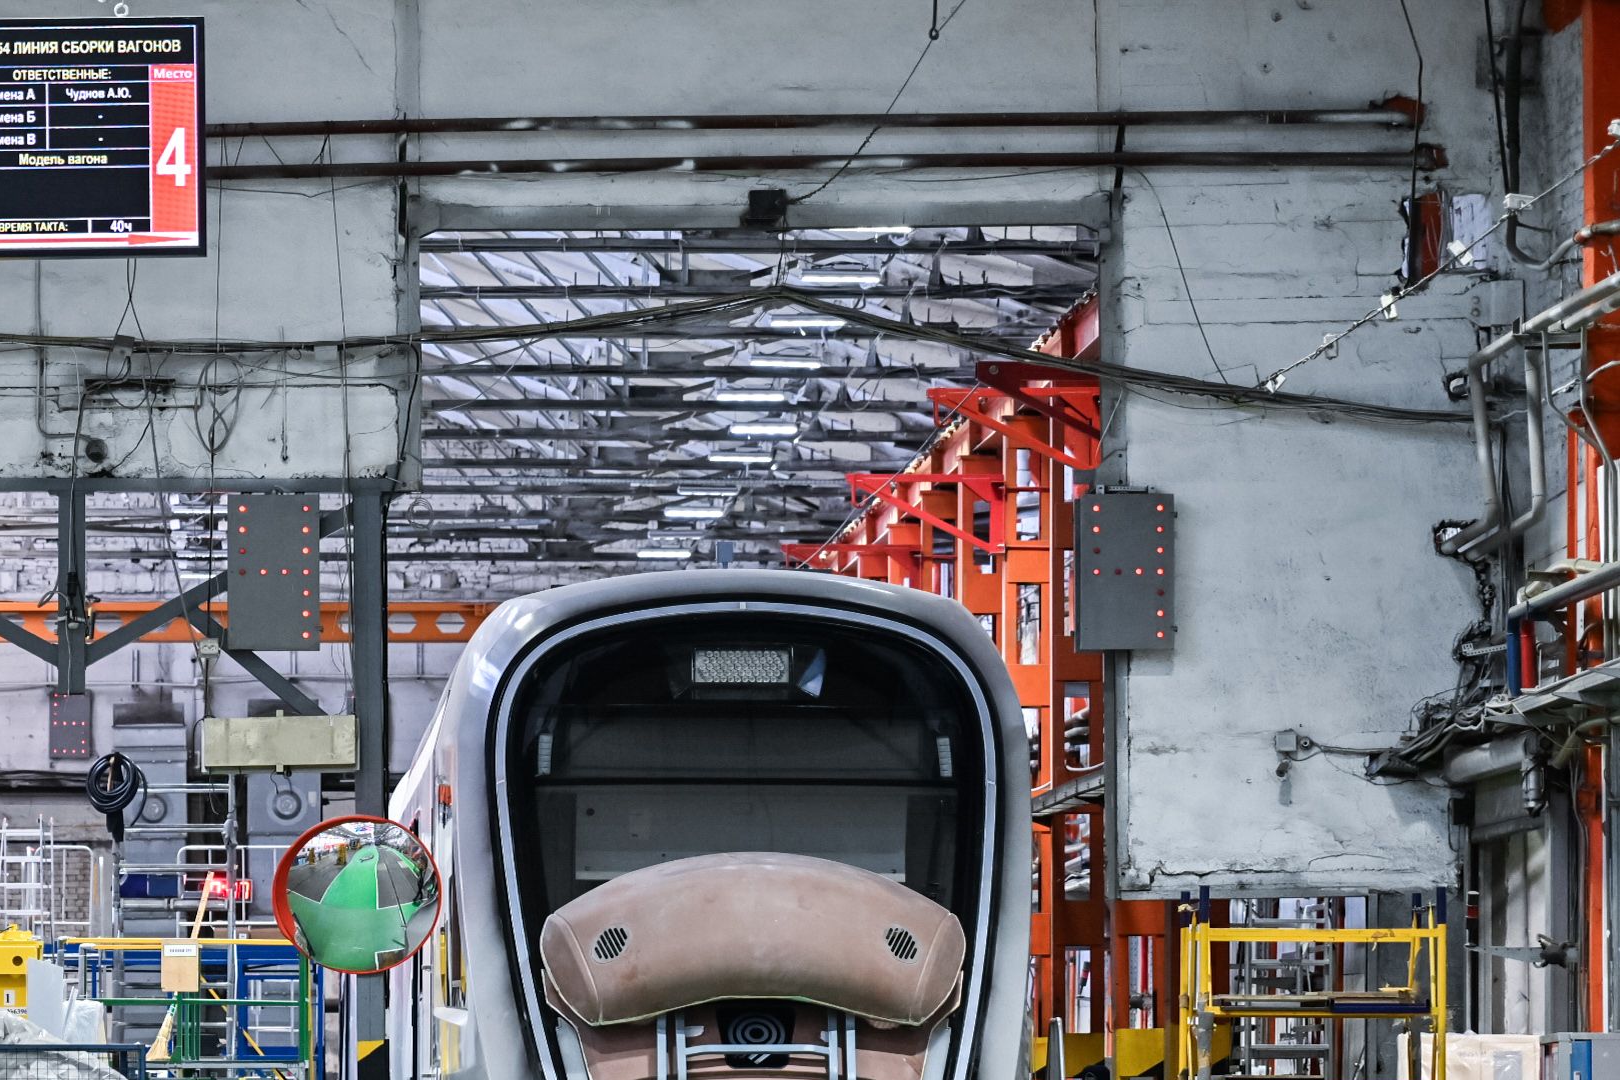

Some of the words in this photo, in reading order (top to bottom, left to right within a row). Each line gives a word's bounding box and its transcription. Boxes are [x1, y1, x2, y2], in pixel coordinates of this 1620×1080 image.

[13, 41, 58, 55] ЛИНИЯ
[61, 40, 115, 54] СБОРКИ
[117, 39, 182, 53] ВАГОНОВ
[12, 69, 112, 81] ОТВЕТСТВЕННЫЕ:
[153, 68, 193, 79] Место
[26, 88, 36, 100] А
[65, 88, 105, 102] Чуднов
[107, 87, 132, 98] А.Ю.
[26, 111, 36, 122] Б
[27, 133, 36, 145] В
[18, 153, 65, 166] Модель
[67, 154, 108, 165] вагона
[155, 127, 191, 187] 4
[34, 221, 68, 232] ТАКТА:
[110, 220, 132, 232] 40ч
[6, 993, 10, 1003] 1
